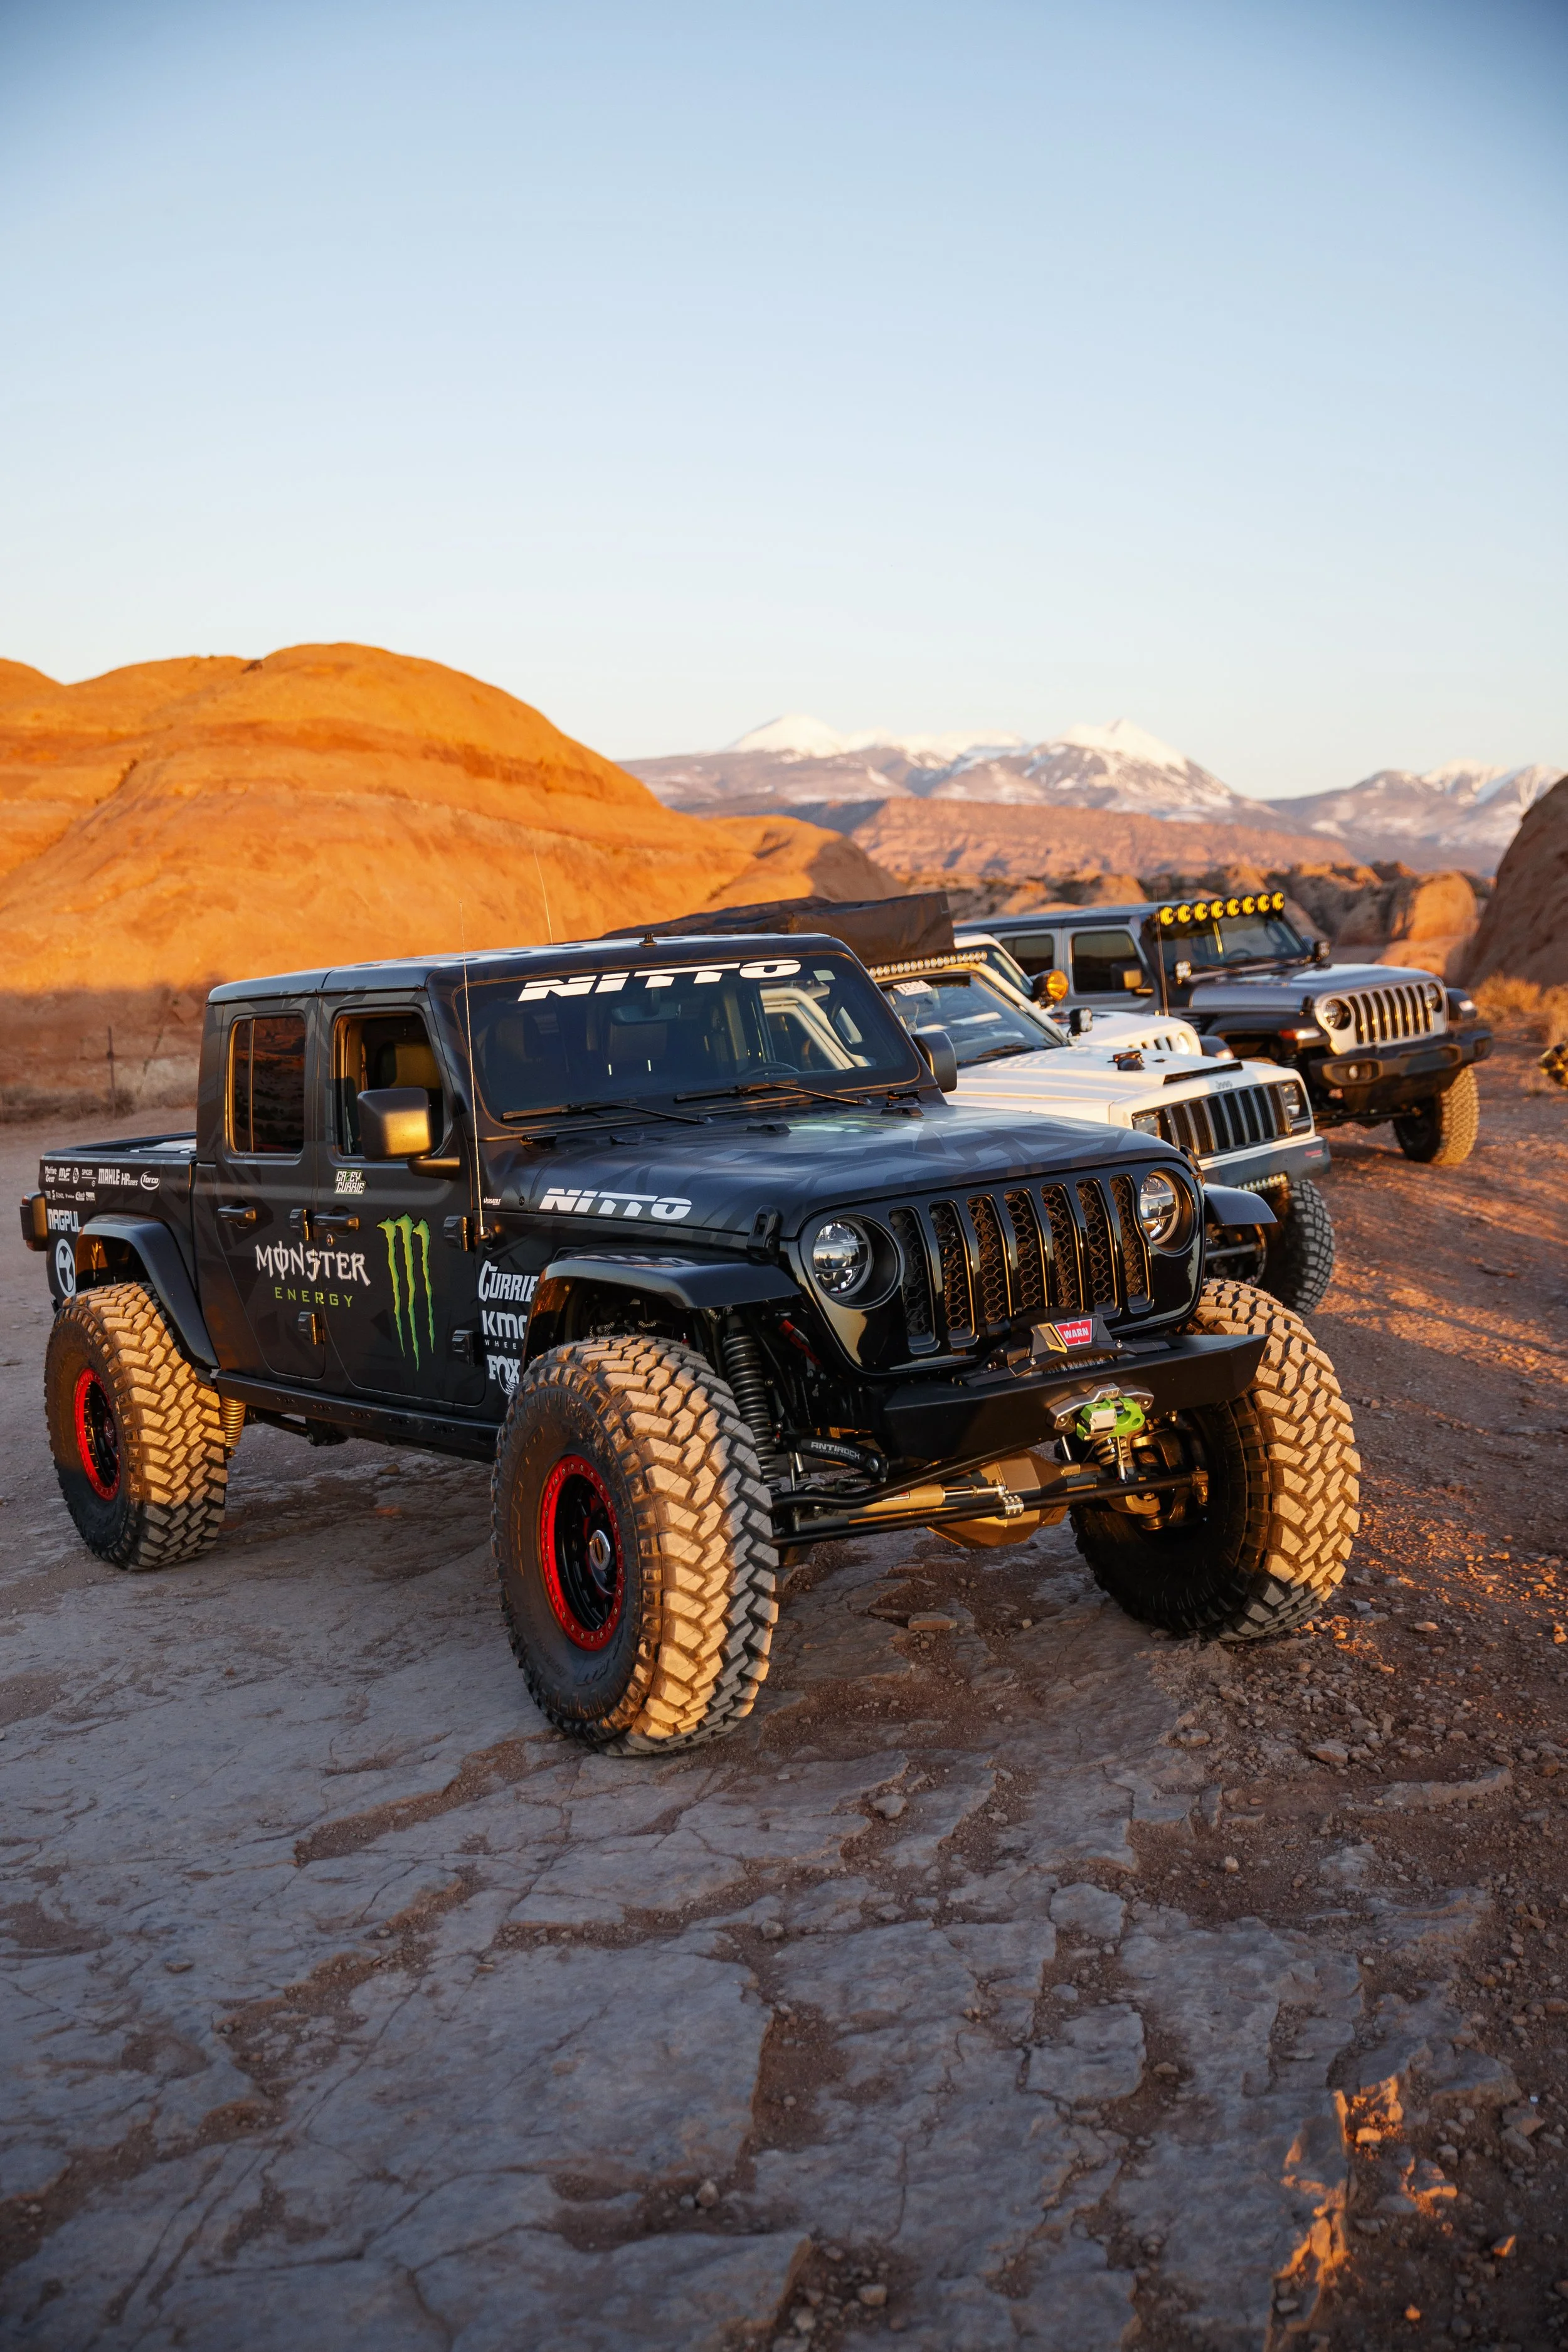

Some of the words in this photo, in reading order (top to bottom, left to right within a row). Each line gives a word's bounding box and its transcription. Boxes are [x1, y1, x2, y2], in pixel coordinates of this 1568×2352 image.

[518, 960, 802, 1002] NITTO
[98, 1168, 120, 1185] MAHLE
[336, 1182, 364, 1193] CURRIE
[539, 1188, 692, 1219] NITTO
[47, 1208, 82, 1232] MAGPUL
[255, 1241, 371, 1286] MONSTER
[275, 1286, 352, 1307] ENERGY
[1064, 1327, 1089, 1339] WARN
[485, 1339, 523, 1350] WHEE
[487, 1353, 520, 1384] FOX
[811, 1441, 860, 1459] ANTIROCK
